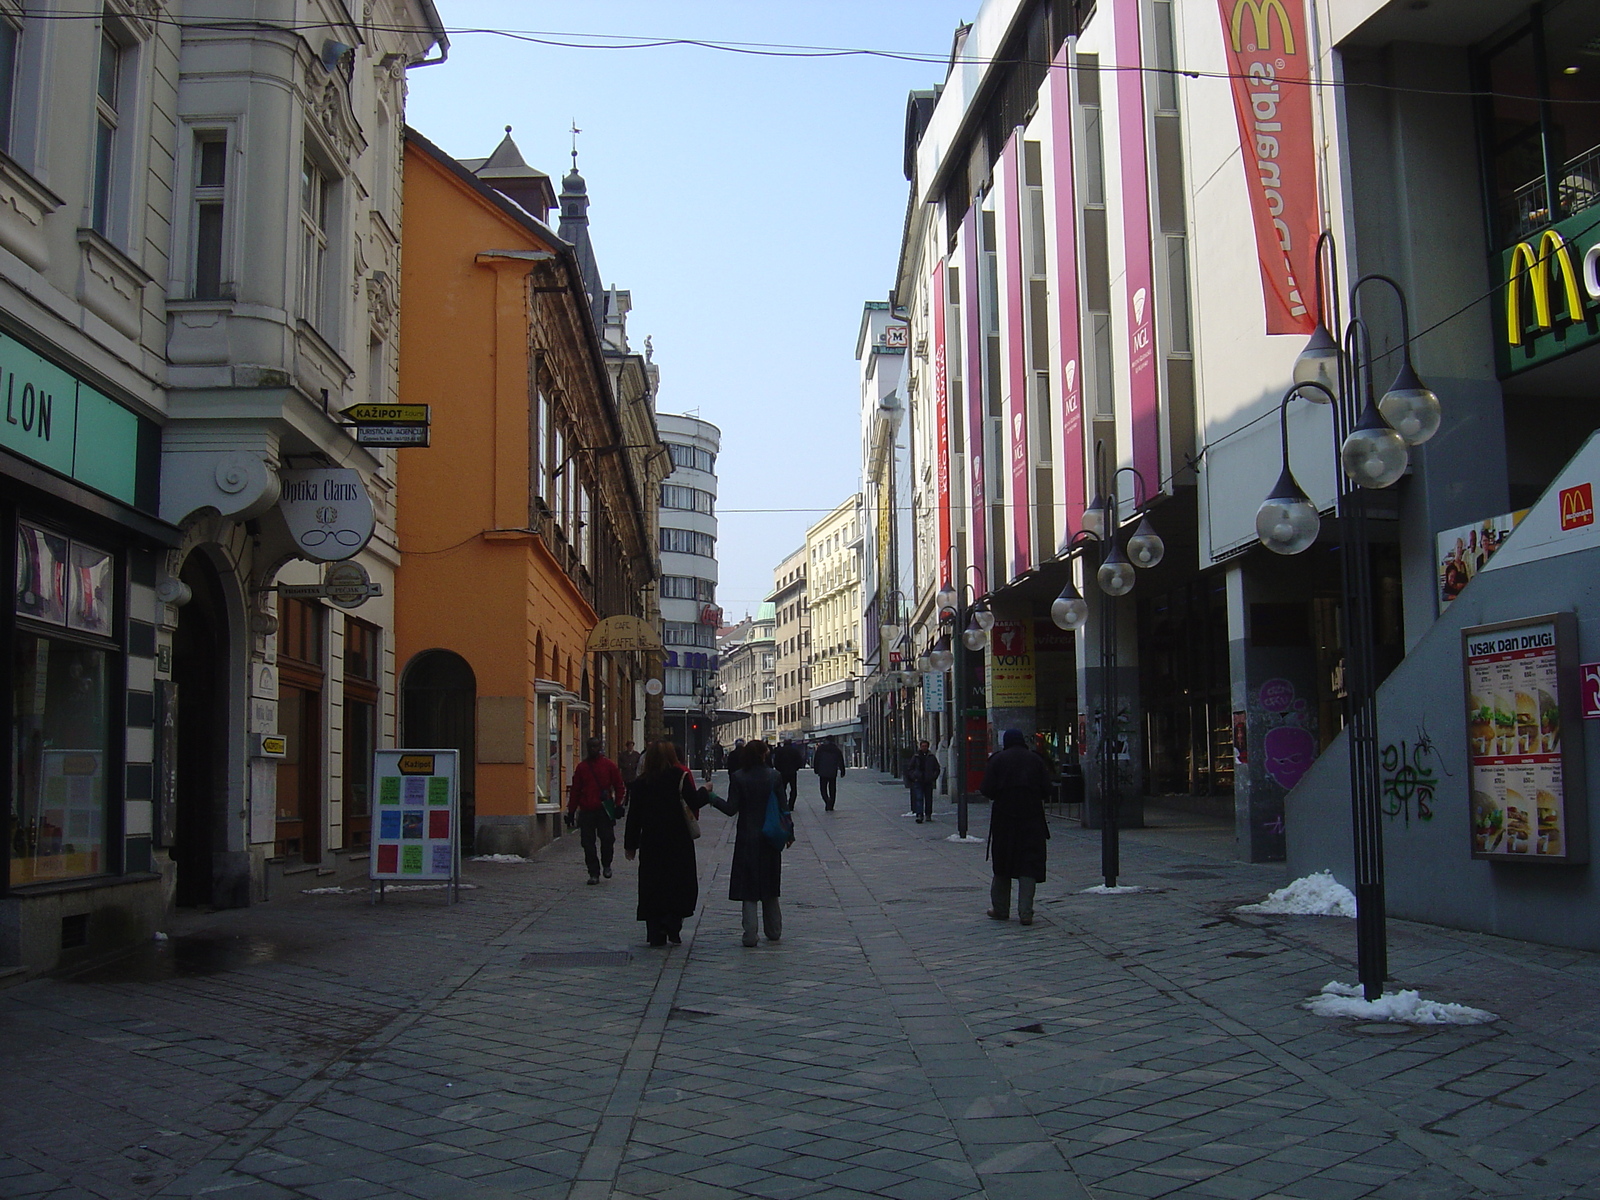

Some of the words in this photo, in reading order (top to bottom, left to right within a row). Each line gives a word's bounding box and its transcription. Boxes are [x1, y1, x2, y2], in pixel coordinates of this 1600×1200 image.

[0, 366, 52, 442] LON
[356, 407, 402, 418] KAŽIPOT
[282, 480, 318, 503] Optika
[323, 480, 358, 501] Clarus
[404, 760, 431, 770] Kažipot
